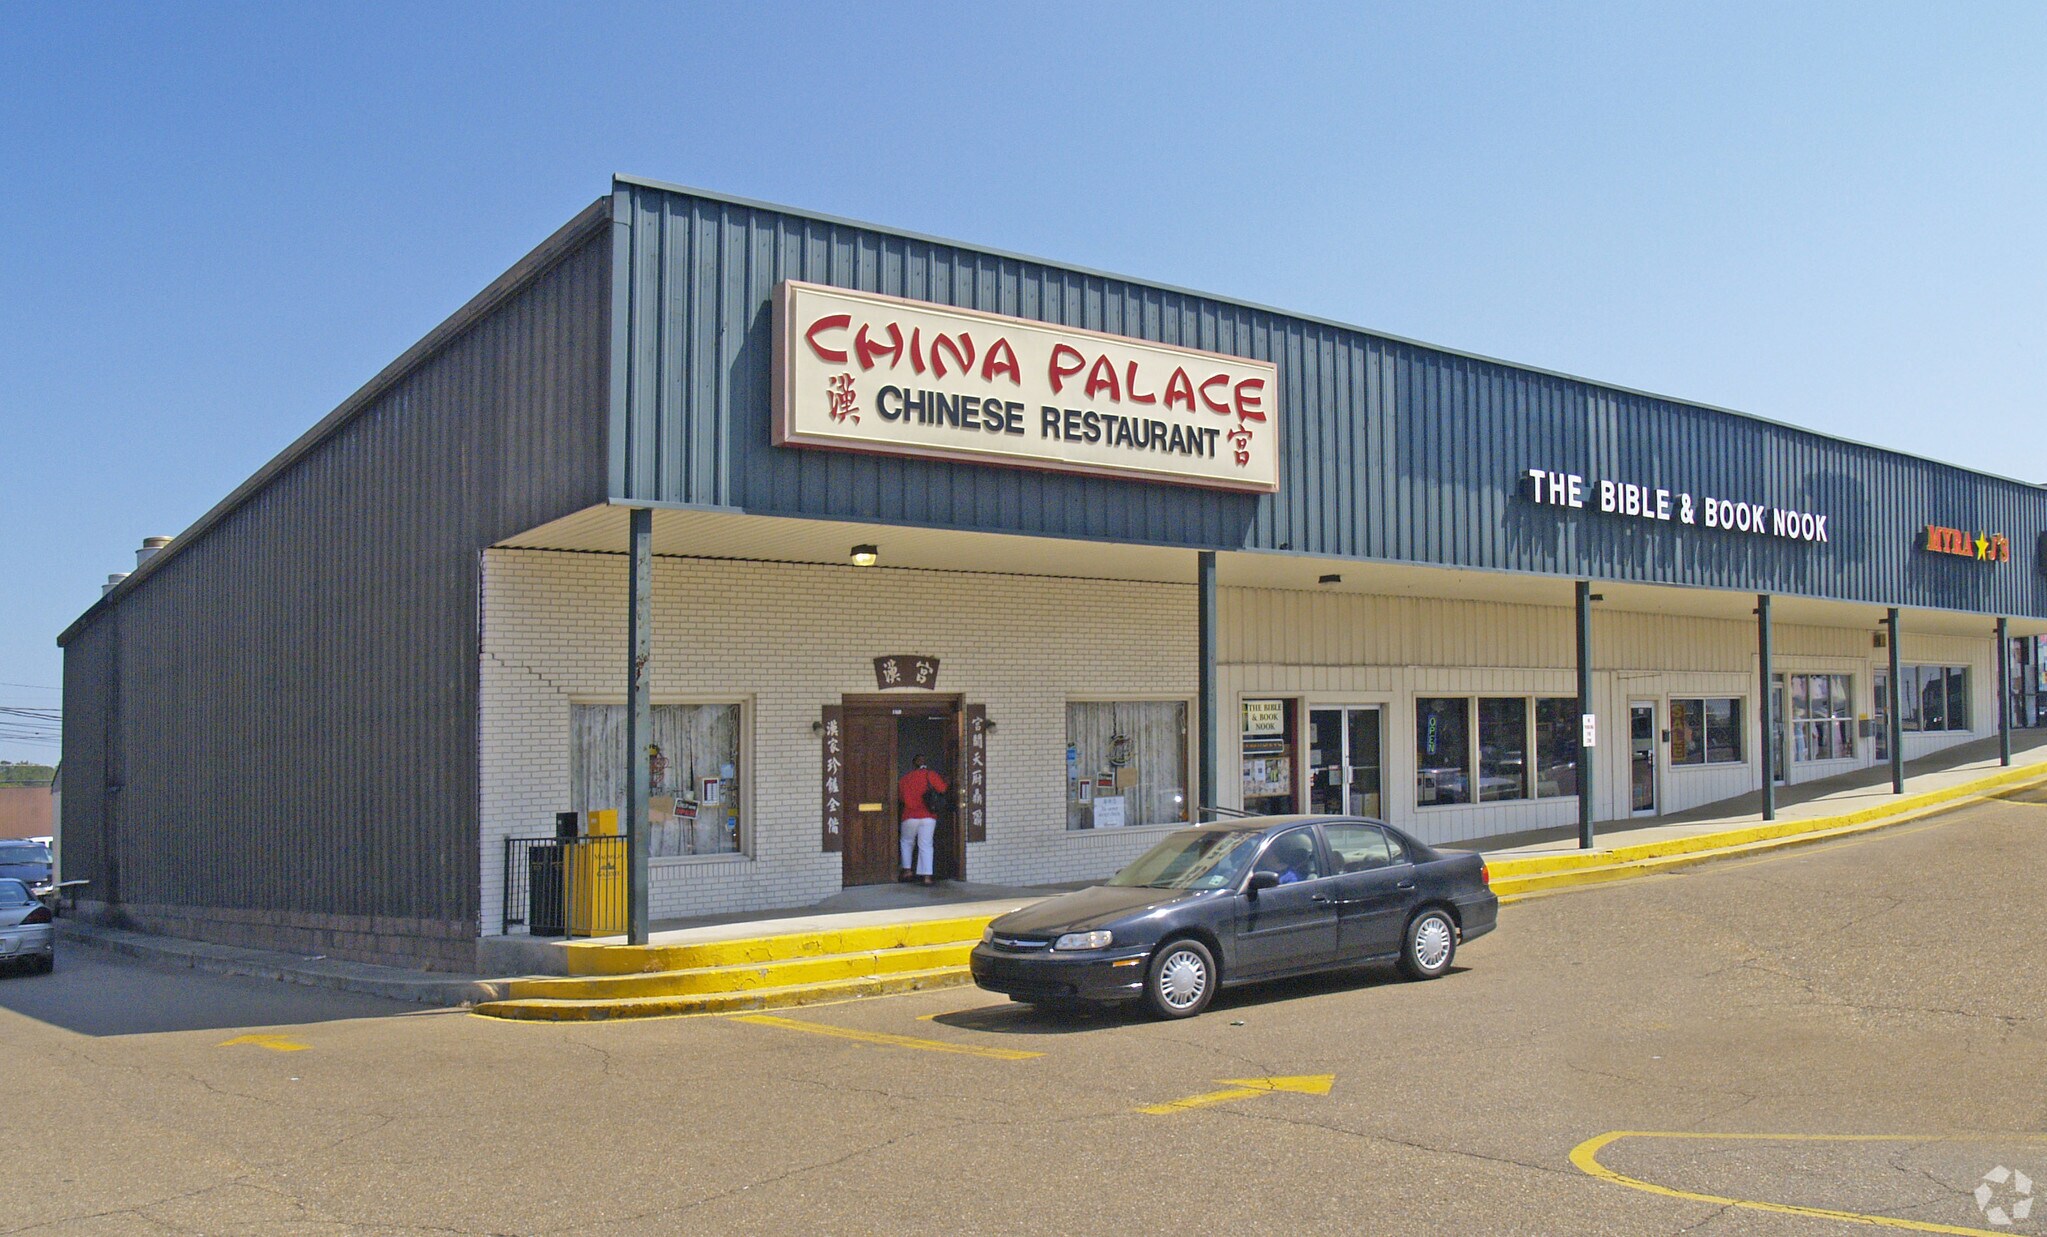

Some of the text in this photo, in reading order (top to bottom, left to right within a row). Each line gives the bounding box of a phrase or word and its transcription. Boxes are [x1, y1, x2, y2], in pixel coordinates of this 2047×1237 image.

[805, 313, 1267, 422] CHINA PALACE
[827, 372, 861, 425] 漢
[875, 384, 1220, 458] CHINESE RESTAURANT
[1529, 469, 1828, 542] THE BIBLE & BOOK NOOK
[1926, 524, 1974, 557] MYRA
[1249, 703, 1282, 711] THE BIBLE
[1251, 713, 1279, 721] & BOOK
[1255, 722, 1276, 730] NOOK
